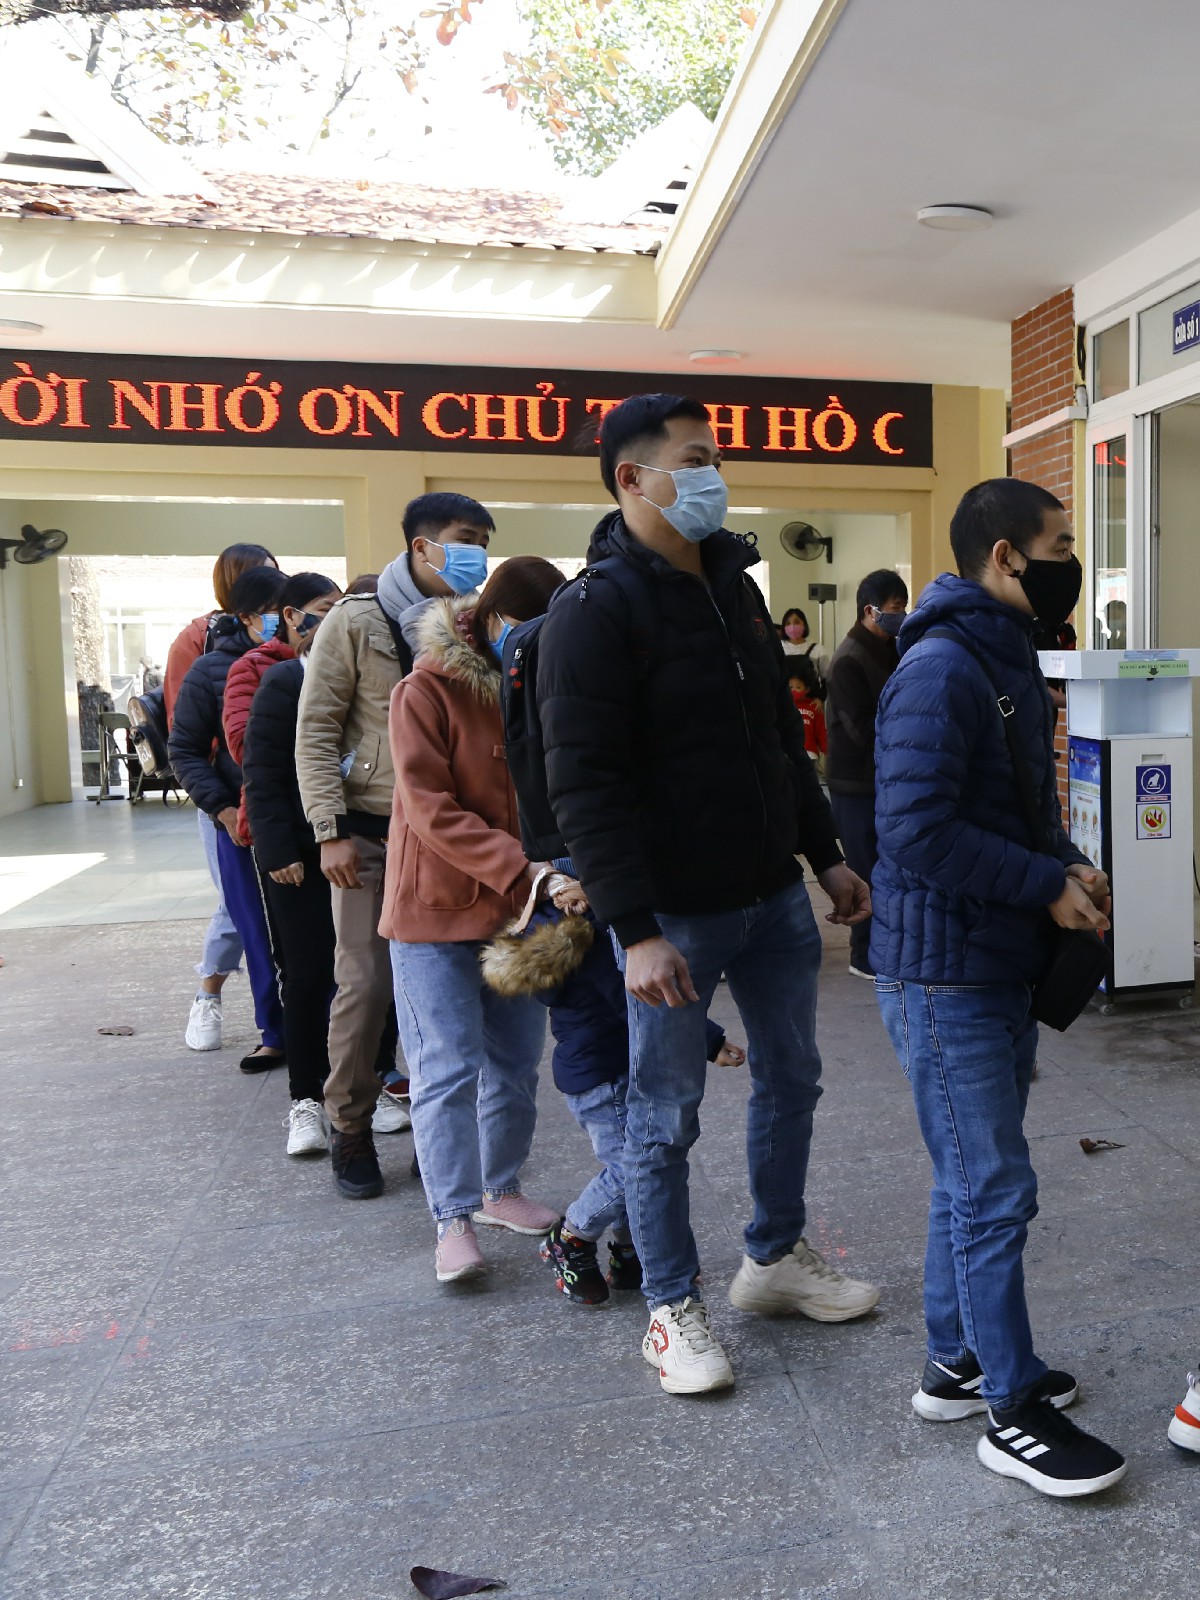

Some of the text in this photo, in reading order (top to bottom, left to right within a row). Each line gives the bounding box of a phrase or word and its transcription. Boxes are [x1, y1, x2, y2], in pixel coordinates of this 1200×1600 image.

[1195, 317, 1199, 337] 1
[107, 371, 283, 433] NHỚ
[299, 384, 404, 438] ƠN
[421, 382, 571, 442] CHỦ
[762, 395, 857, 452] HỒ
